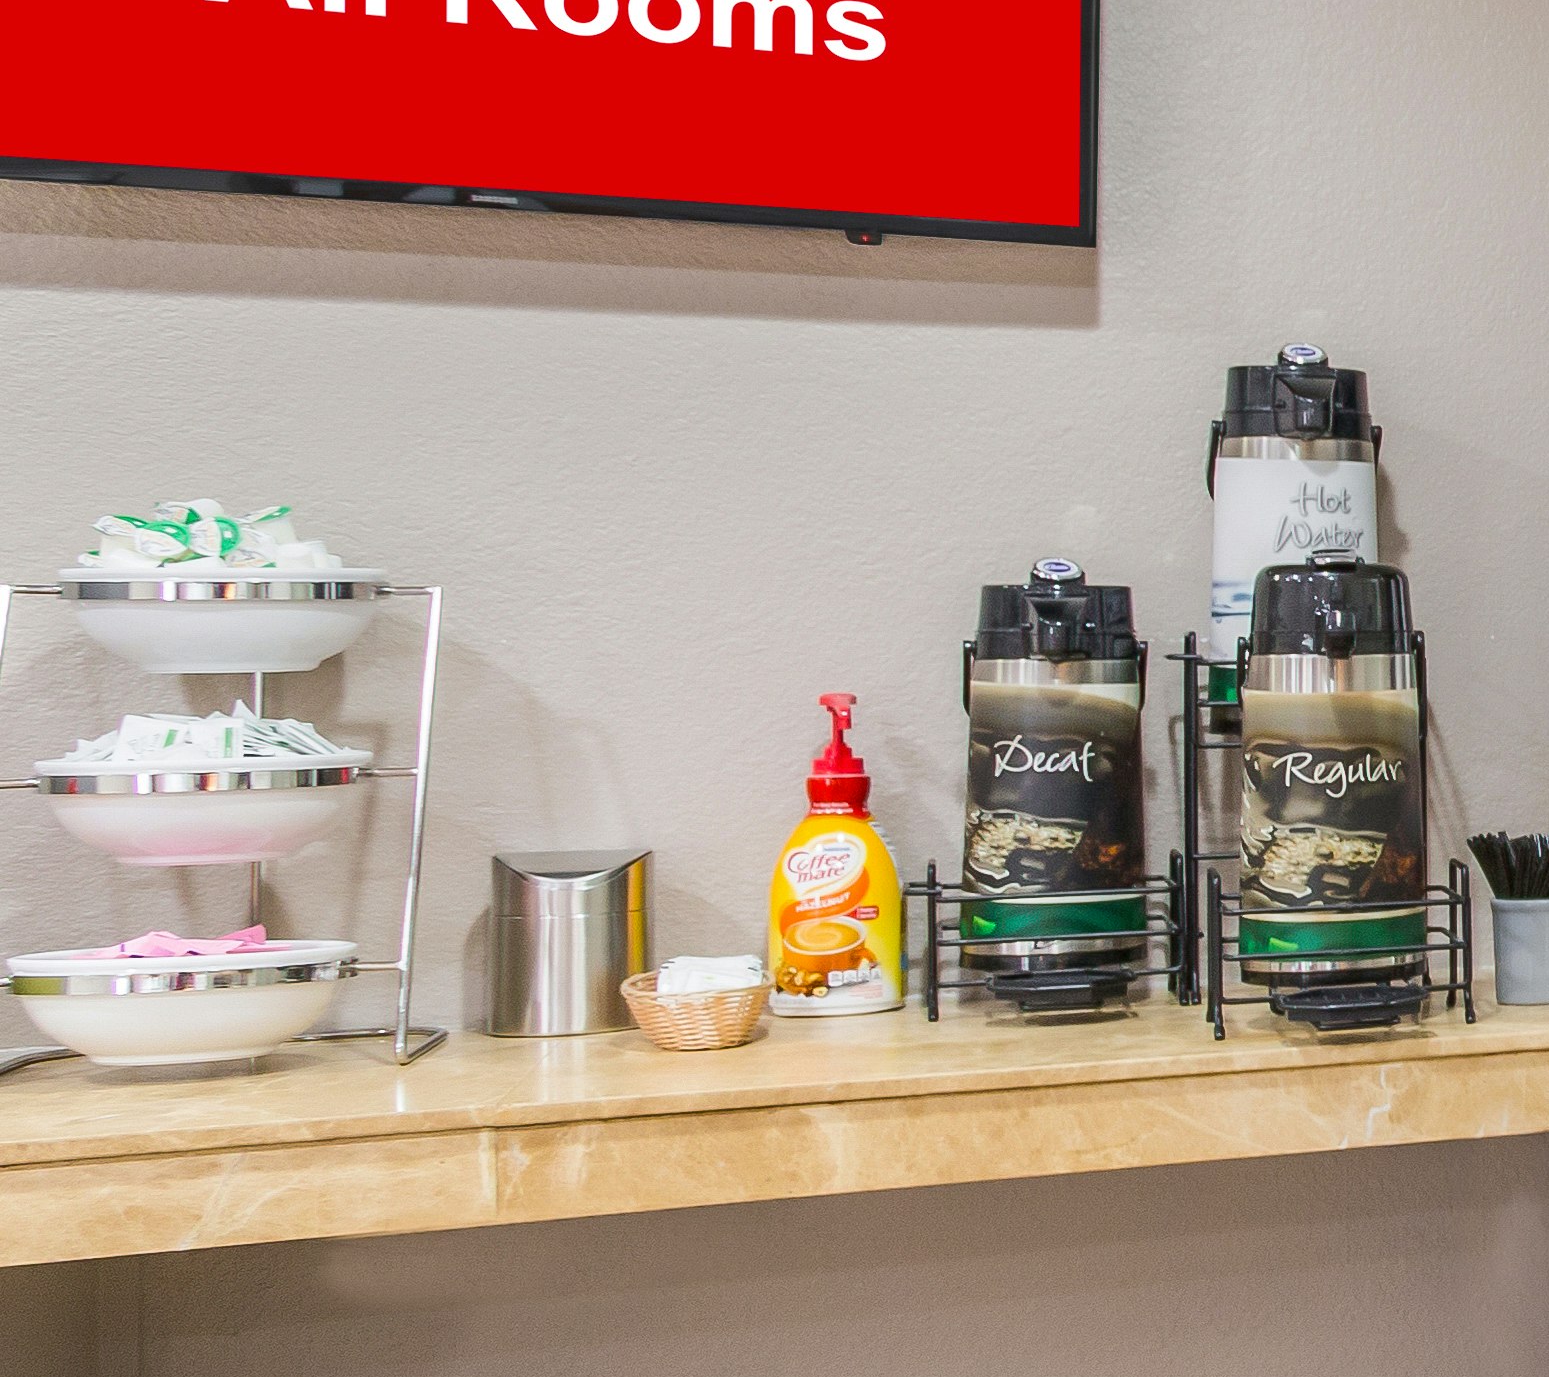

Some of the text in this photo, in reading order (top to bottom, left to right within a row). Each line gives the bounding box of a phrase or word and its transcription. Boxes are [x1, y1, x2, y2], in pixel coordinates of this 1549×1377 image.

[1290, 482, 1351, 517] Hot
[1273, 516, 1364, 552] Water
[994, 734, 1096, 782] Decaf
[1272, 752, 1402, 798] Regular
[788, 851, 851, 873] Coffee
